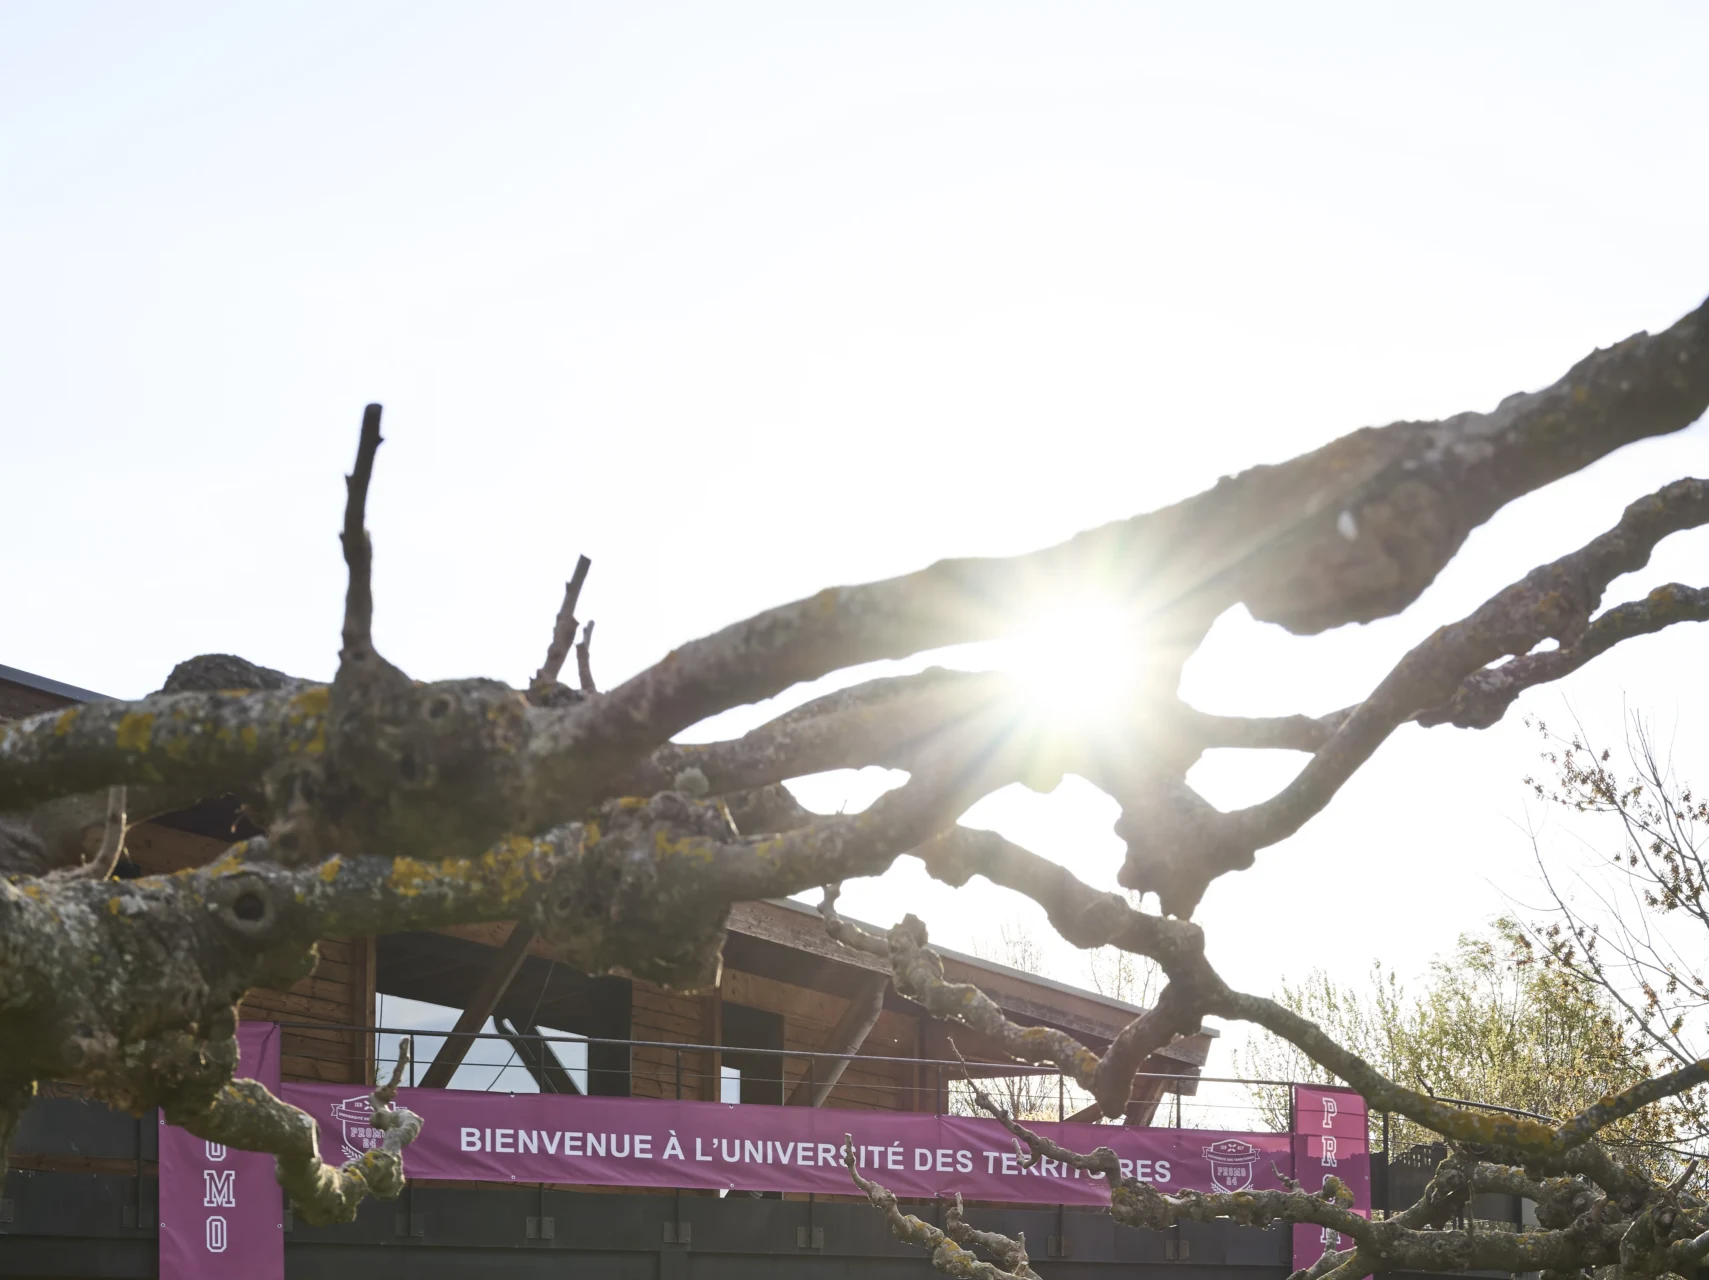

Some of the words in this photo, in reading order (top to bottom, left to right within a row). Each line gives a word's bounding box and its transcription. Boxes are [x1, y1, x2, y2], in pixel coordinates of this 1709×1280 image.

[460, 1127, 653, 1159] BIENVENUE
[662, 1129, 685, 1160] À
[914, 1148, 973, 1173] DES
[982, 1151, 1171, 1183] TERRIRES
